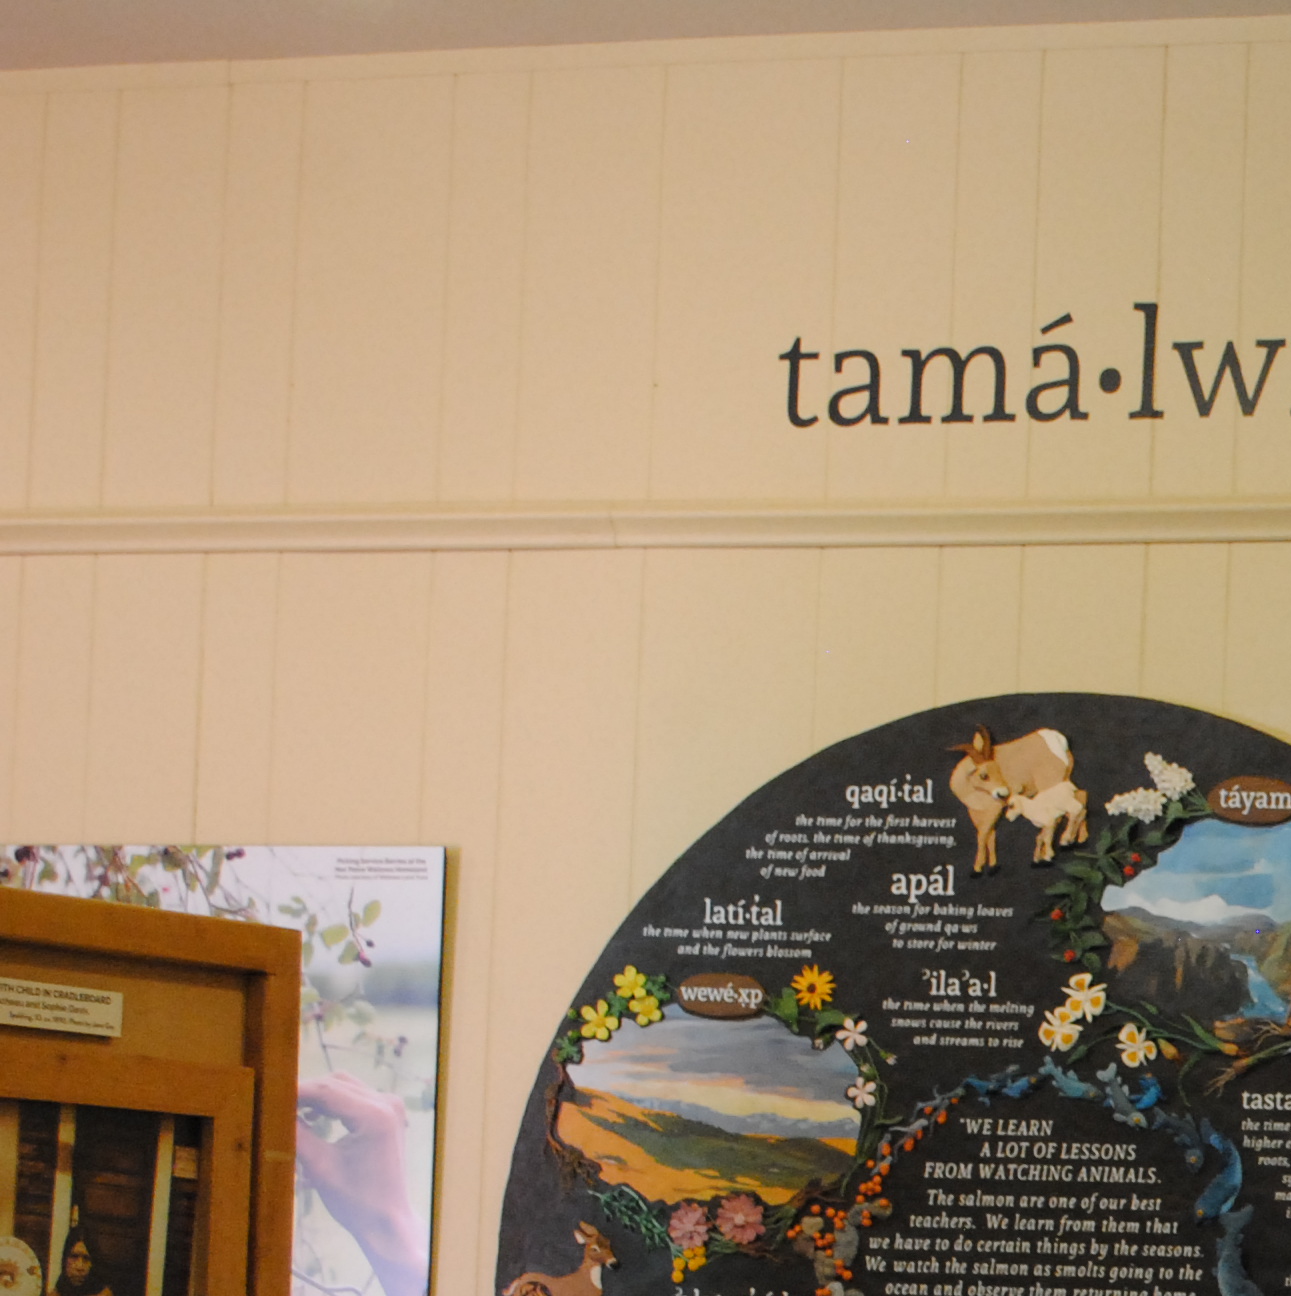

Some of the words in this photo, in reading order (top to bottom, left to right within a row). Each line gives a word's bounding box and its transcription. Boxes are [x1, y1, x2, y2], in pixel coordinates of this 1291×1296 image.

[890, 864, 956, 907] apál
[996, 1118, 1054, 1137] LEARN
[979, 1141, 991, 1158] A
[996, 1141, 1030, 1158] LOT
[1033, 1141, 1058, 1159] OF
[1060, 1142, 1137, 1161] LESSONS
[923, 1161, 974, 1180] FROM
[978, 1162, 1073, 1182] WATCHING
[1076, 1166, 1162, 1185] ANIMALS.
